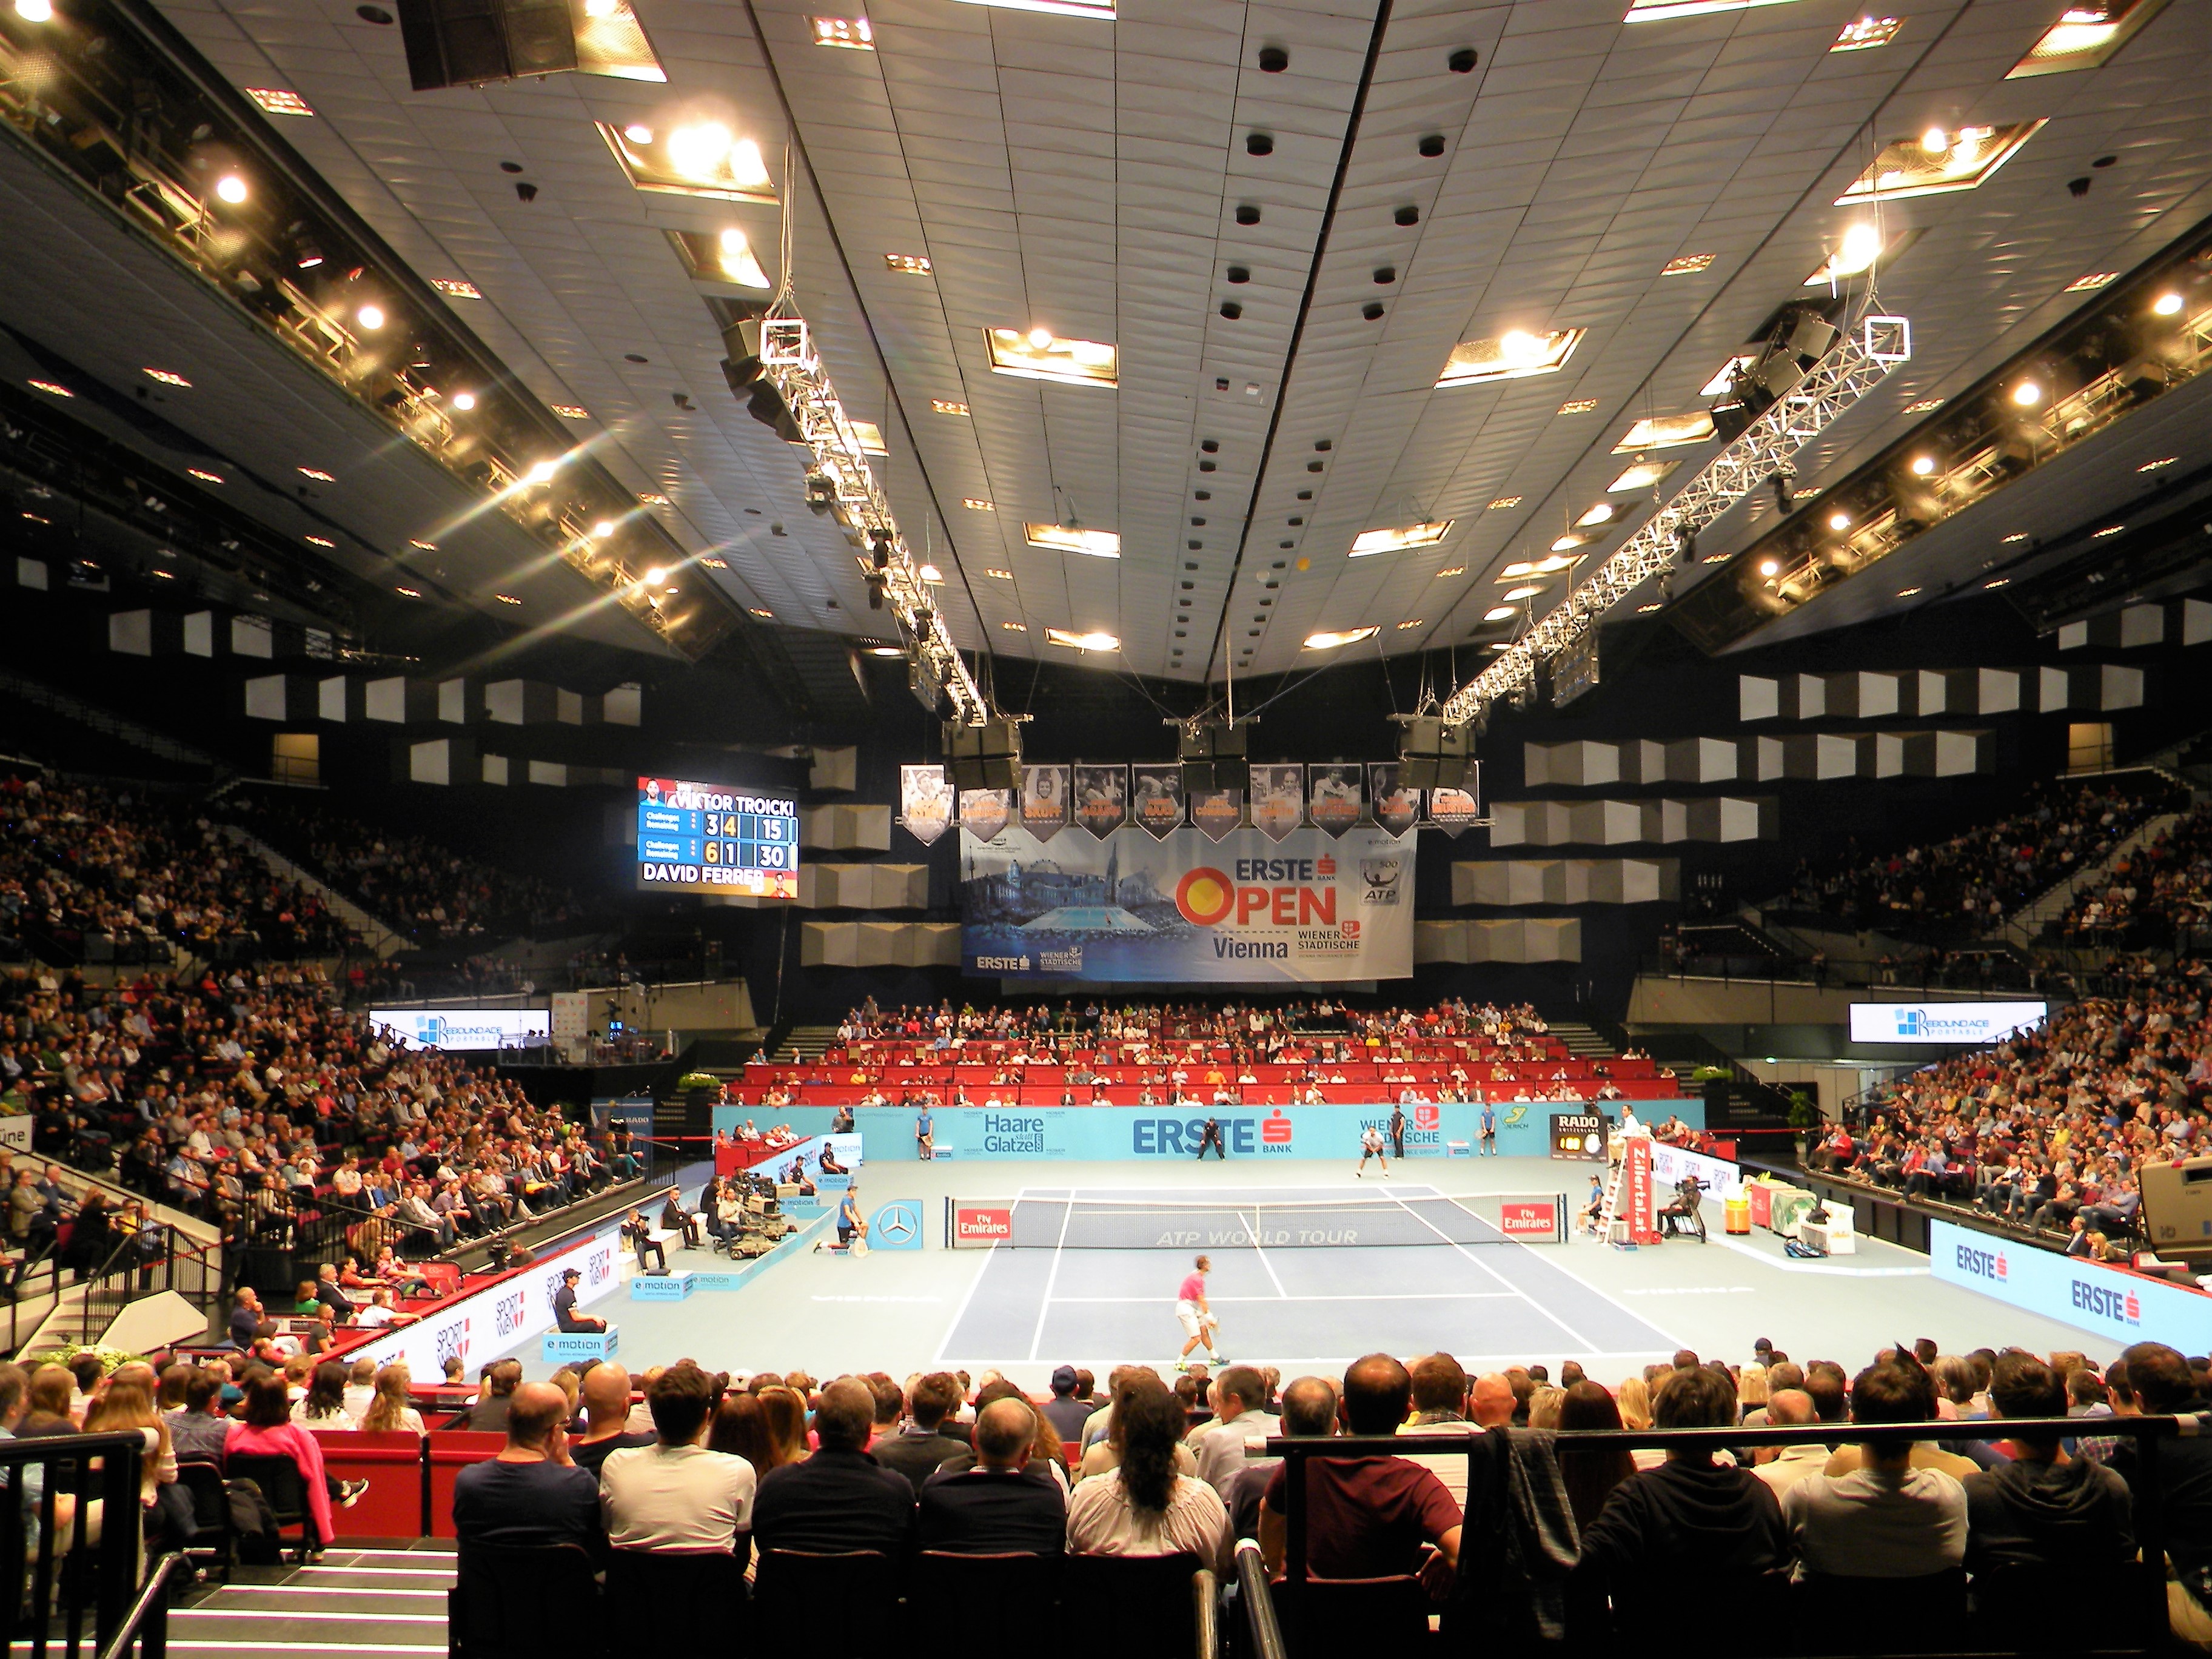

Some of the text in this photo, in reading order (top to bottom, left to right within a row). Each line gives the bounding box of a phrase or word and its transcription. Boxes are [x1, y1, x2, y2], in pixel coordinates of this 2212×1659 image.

[675, 790, 795, 817] VIKTOR TROICKI
[646, 811, 680, 822] Challenges
[706, 814, 782, 840] 3 4 15
[646, 840, 680, 850] Challenges
[706, 841, 784, 867] 6 1 30
[643, 863, 765, 886] DAVID FERRER
[1236, 859, 1313, 880] ERSTE
[1365, 890, 1396, 899] ATP
[1298, 931, 1340, 939] WIENER
[1213, 937, 1289, 959] Vienna
[976, 956, 1018, 970] ERSTE
[985, 1114, 1044, 1133] Haare
[1360, 1119, 1413, 1130] WIENR
[1558, 1116, 1599, 1128] RADO
[984, 1135, 1034, 1153] Glatze
[1133, 1119, 1255, 1154] ERSTE
[1634, 1147, 1647, 1233] Zillertal.at
[977, 1214, 992, 1224] Fly
[1504, 1218, 1551, 1229] Emirates
[1521, 1209, 1535, 1220] Fly
[960, 1222, 1008, 1234] Emirates
[1156, 1231, 1201, 1245] ATP
[1298, 1230, 1358, 1244] TOUR
[589, 1250, 605, 1273] SPORT
[1957, 1244, 1994, 1279] ERSTE
[497, 1293, 518, 1321] SPORT
[2071, 1279, 2123, 1322] ERSTE
[437, 1320, 463, 1352] SPORT
